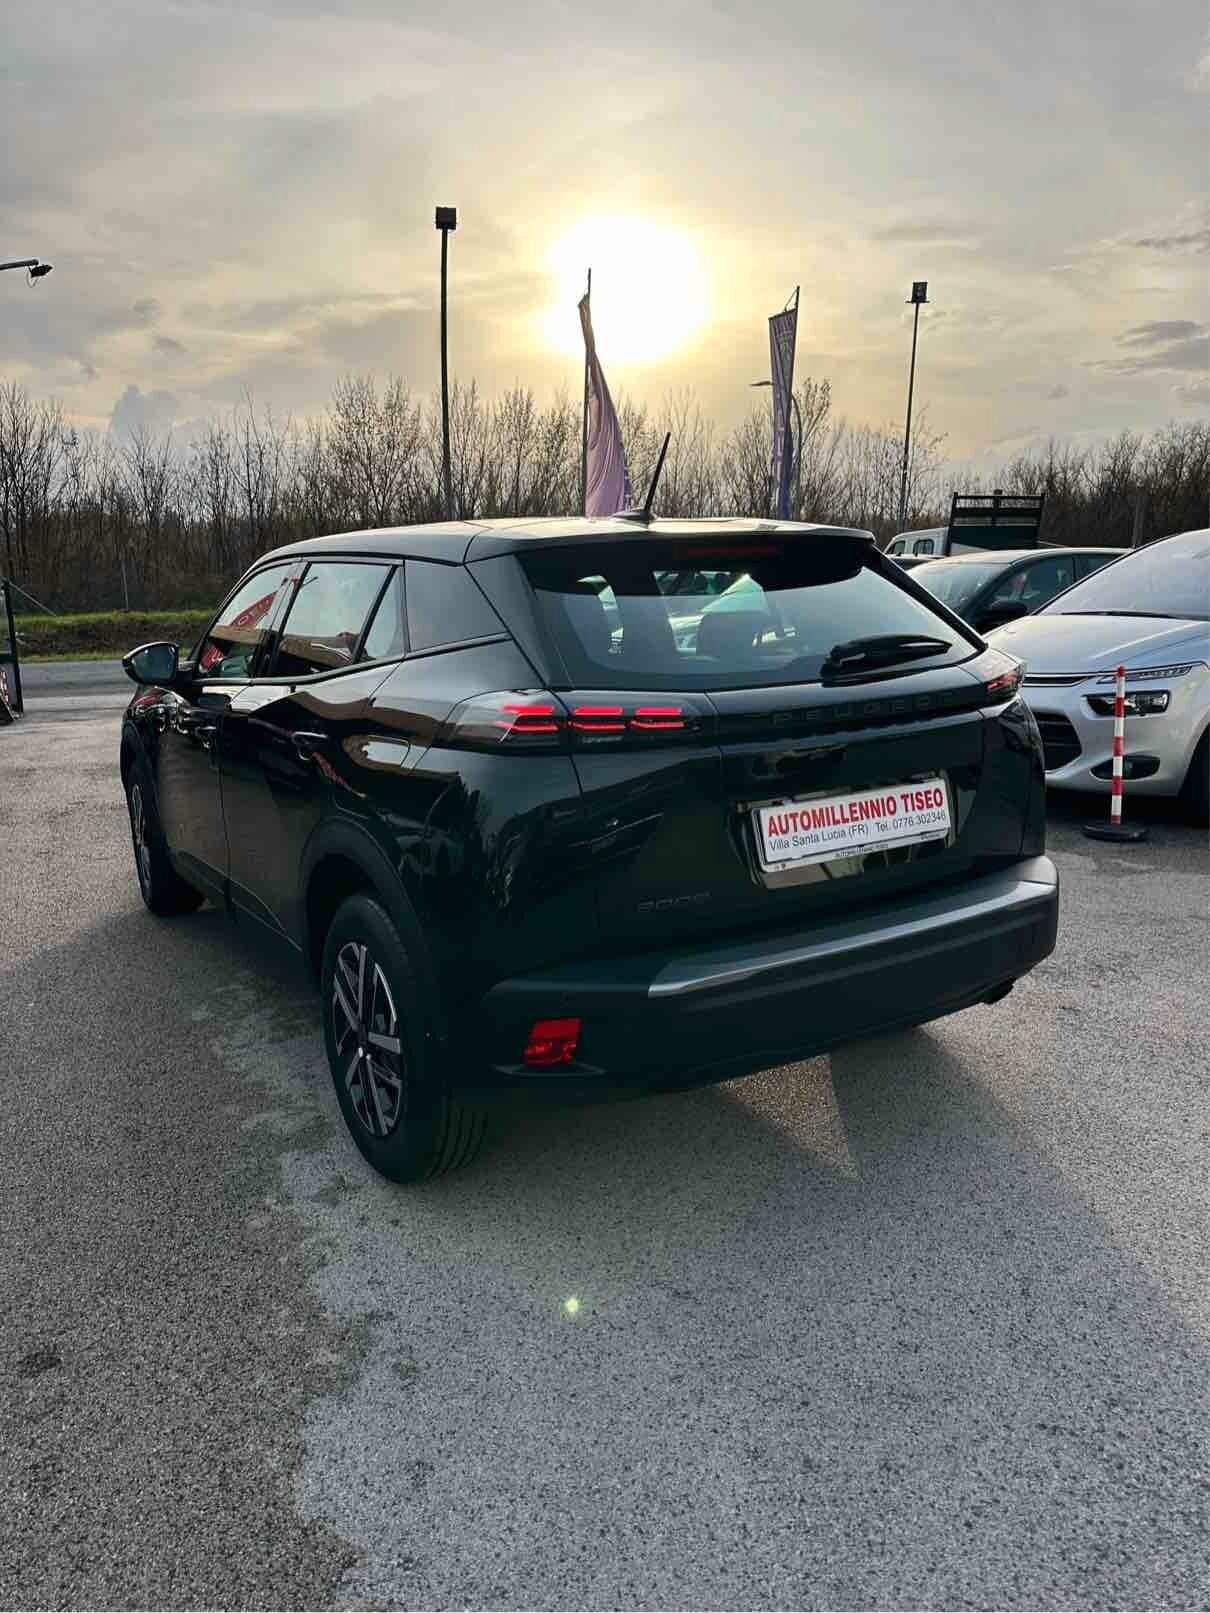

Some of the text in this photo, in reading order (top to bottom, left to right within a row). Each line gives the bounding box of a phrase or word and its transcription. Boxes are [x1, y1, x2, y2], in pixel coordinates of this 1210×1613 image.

[768, 788, 944, 837] AUTOMILLENNIO TISEO
[769, 840, 790, 854] Villa
[792, 834, 820, 849] Santa
[822, 828, 847, 843] Lucia
[849, 823, 869, 839] (FR)
